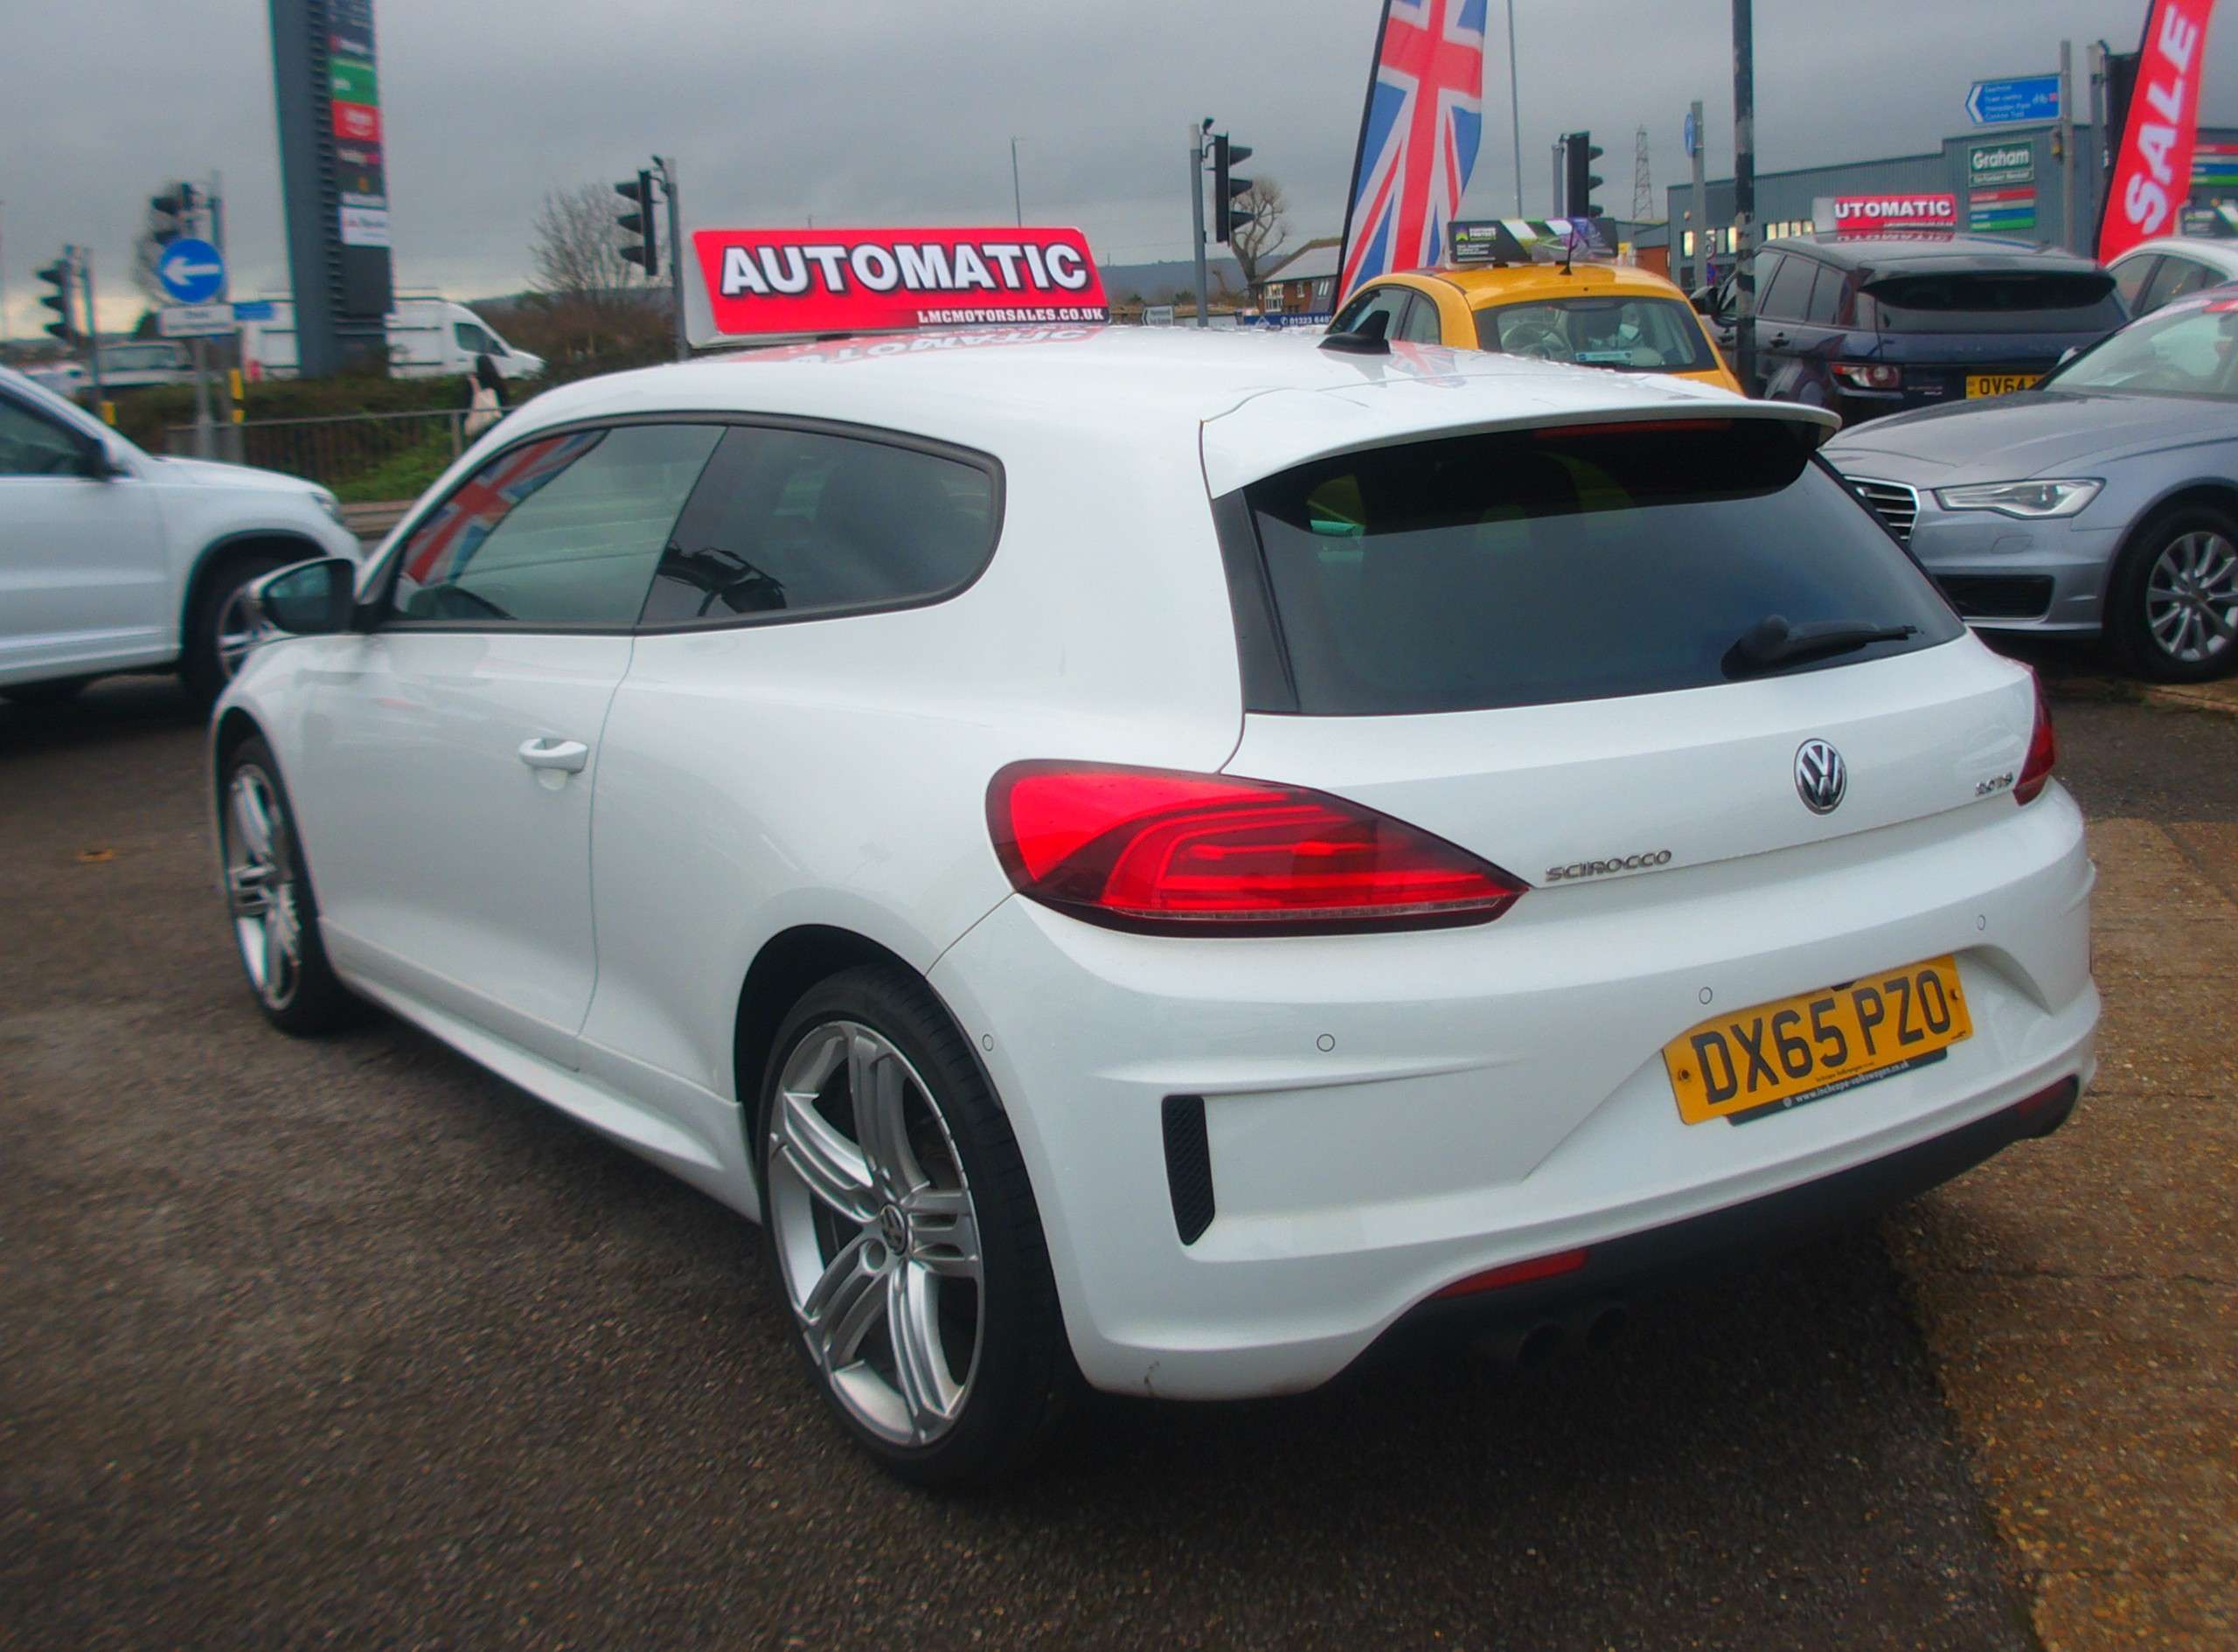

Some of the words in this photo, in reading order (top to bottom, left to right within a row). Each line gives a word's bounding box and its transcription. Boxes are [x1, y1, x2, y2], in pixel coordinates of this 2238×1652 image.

[2125, 3, 2195, 234] SALE
[1972, 149, 2029, 170] Graham
[720, 242, 1088, 295] AUTOMATIC
[917, 307, 1105, 324] LMCMOTORSALES.CO.UK
[1545, 849, 1672, 883] SCIROCCO
[1691, 997, 1847, 1105] DX65
[1850, 969, 1951, 1057] PZO
